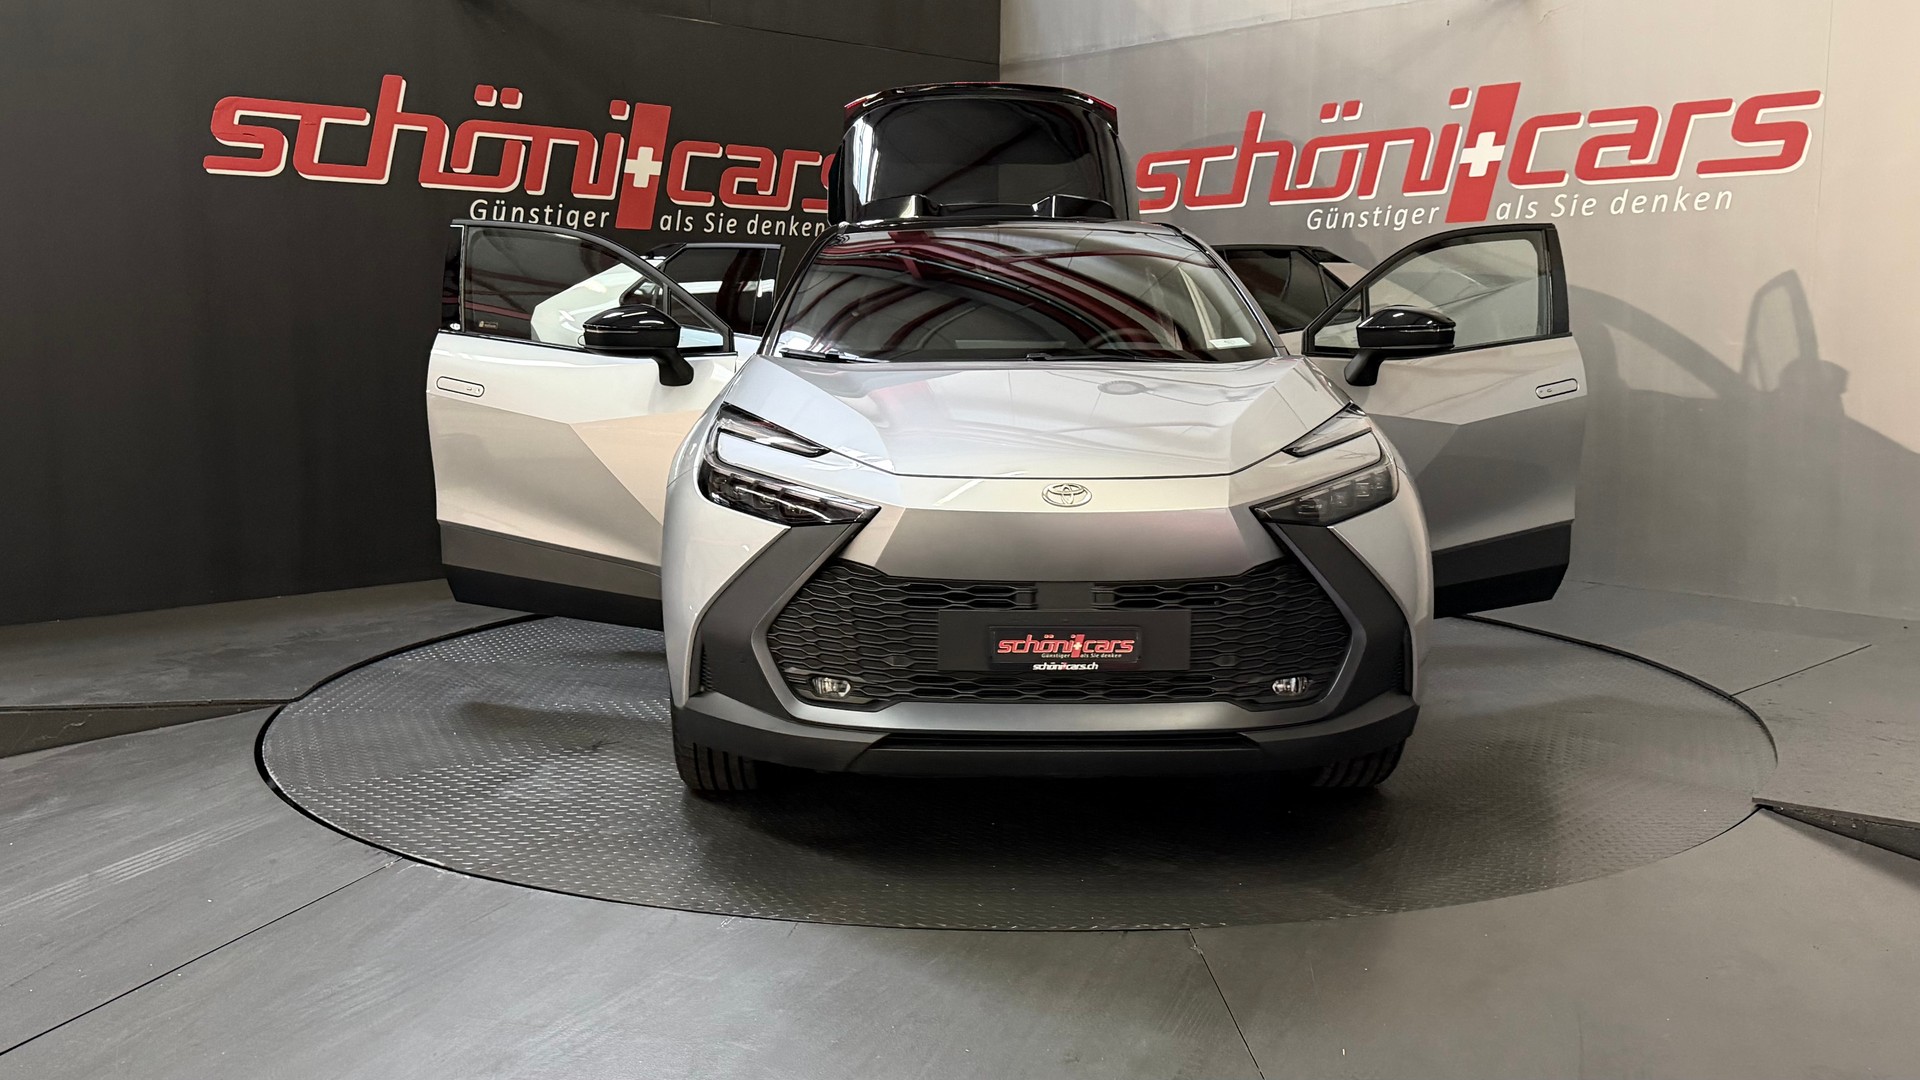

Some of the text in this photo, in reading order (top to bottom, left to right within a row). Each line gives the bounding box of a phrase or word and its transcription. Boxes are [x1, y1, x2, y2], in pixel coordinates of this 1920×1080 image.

[469, 199, 826, 237] Günstiger als Sie denken
[1306, 186, 1733, 231] Günstiger als Sie denken
